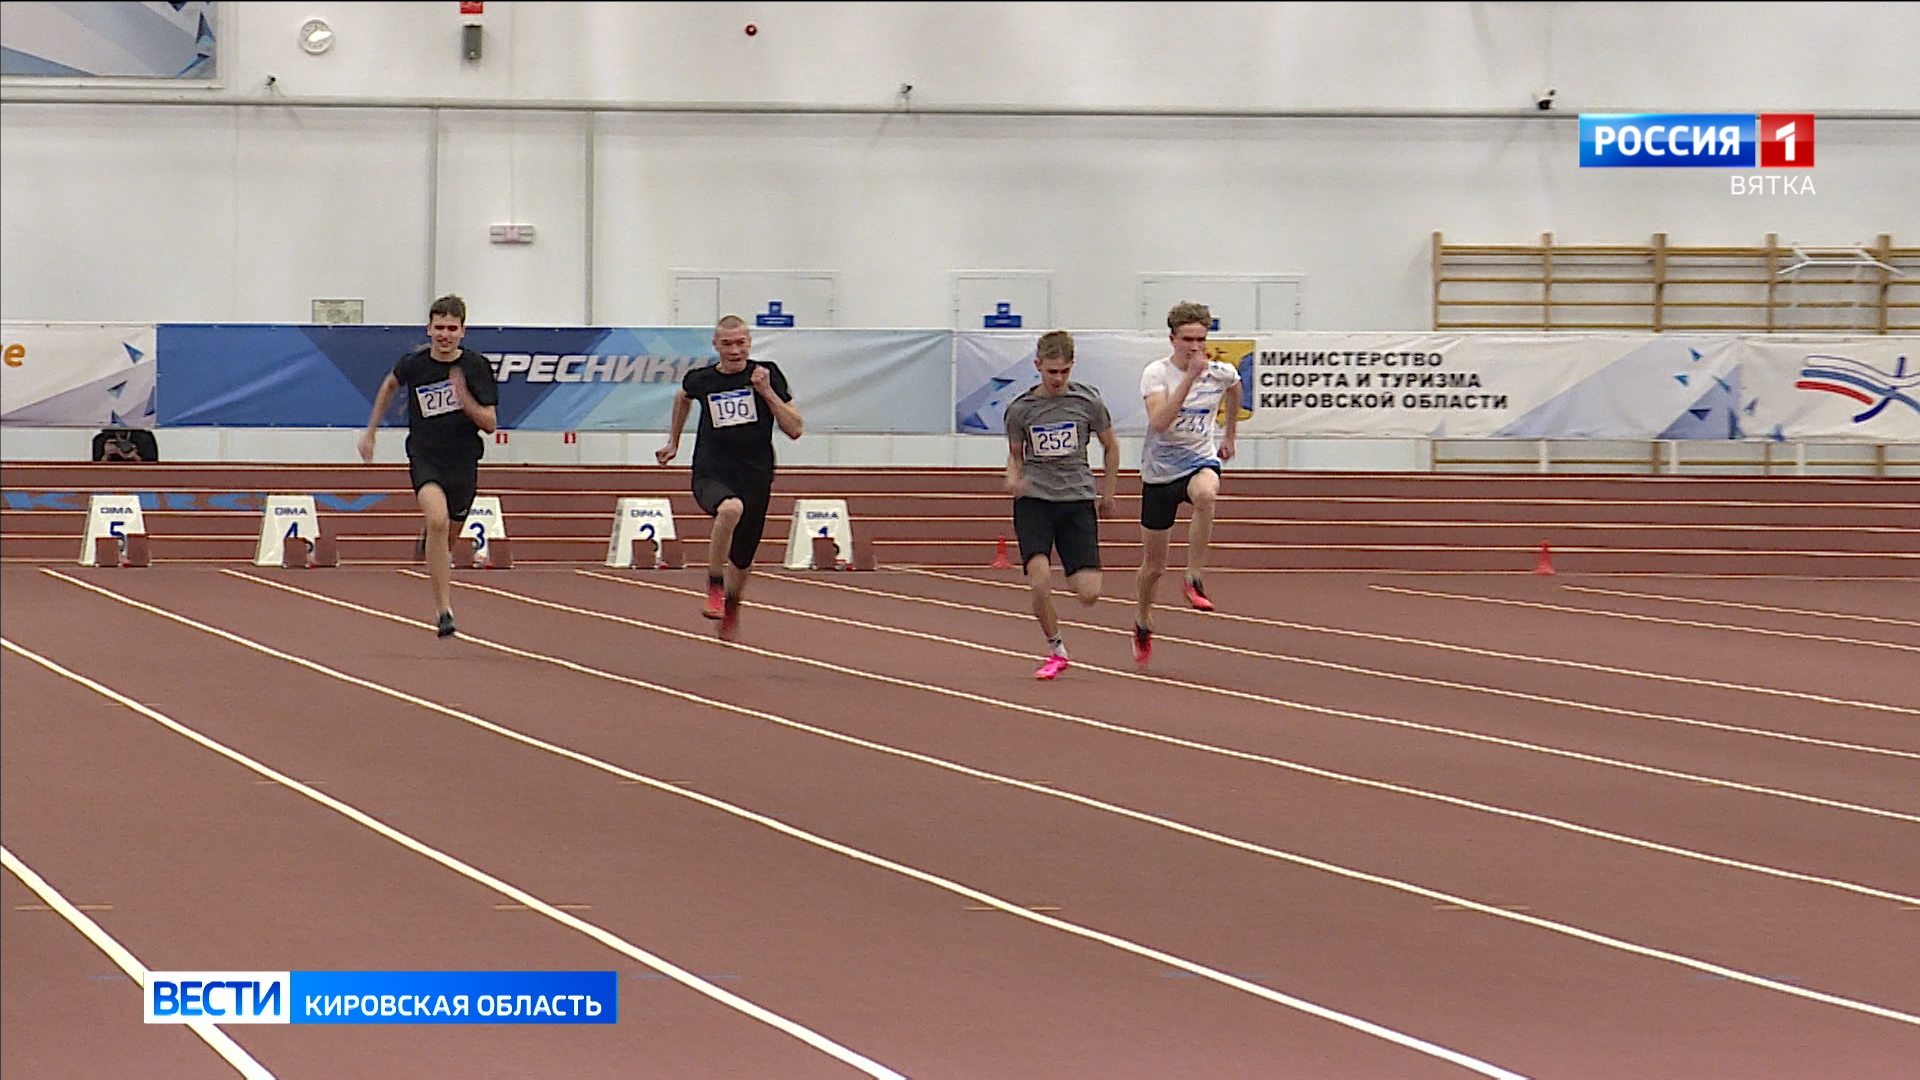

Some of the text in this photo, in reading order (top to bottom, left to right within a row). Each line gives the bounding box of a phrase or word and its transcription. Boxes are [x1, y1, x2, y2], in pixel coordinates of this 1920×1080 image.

[1259, 351, 1444, 367] МИНИСТЕРСТВО
[1259, 373, 1483, 389] СПОРТА И ТУРИЗМА
[424, 390, 457, 410] 272
[1259, 391, 1509, 409] КИРОВСКОЙ ОБЛАСТИ
[716, 399, 749, 420] 196
[1037, 431, 1073, 450] 252
[100, 507, 134, 515] DIMA
[274, 507, 308, 516] DIMA
[630, 509, 665, 518] DIMA
[469, 522, 485, 550] 3
